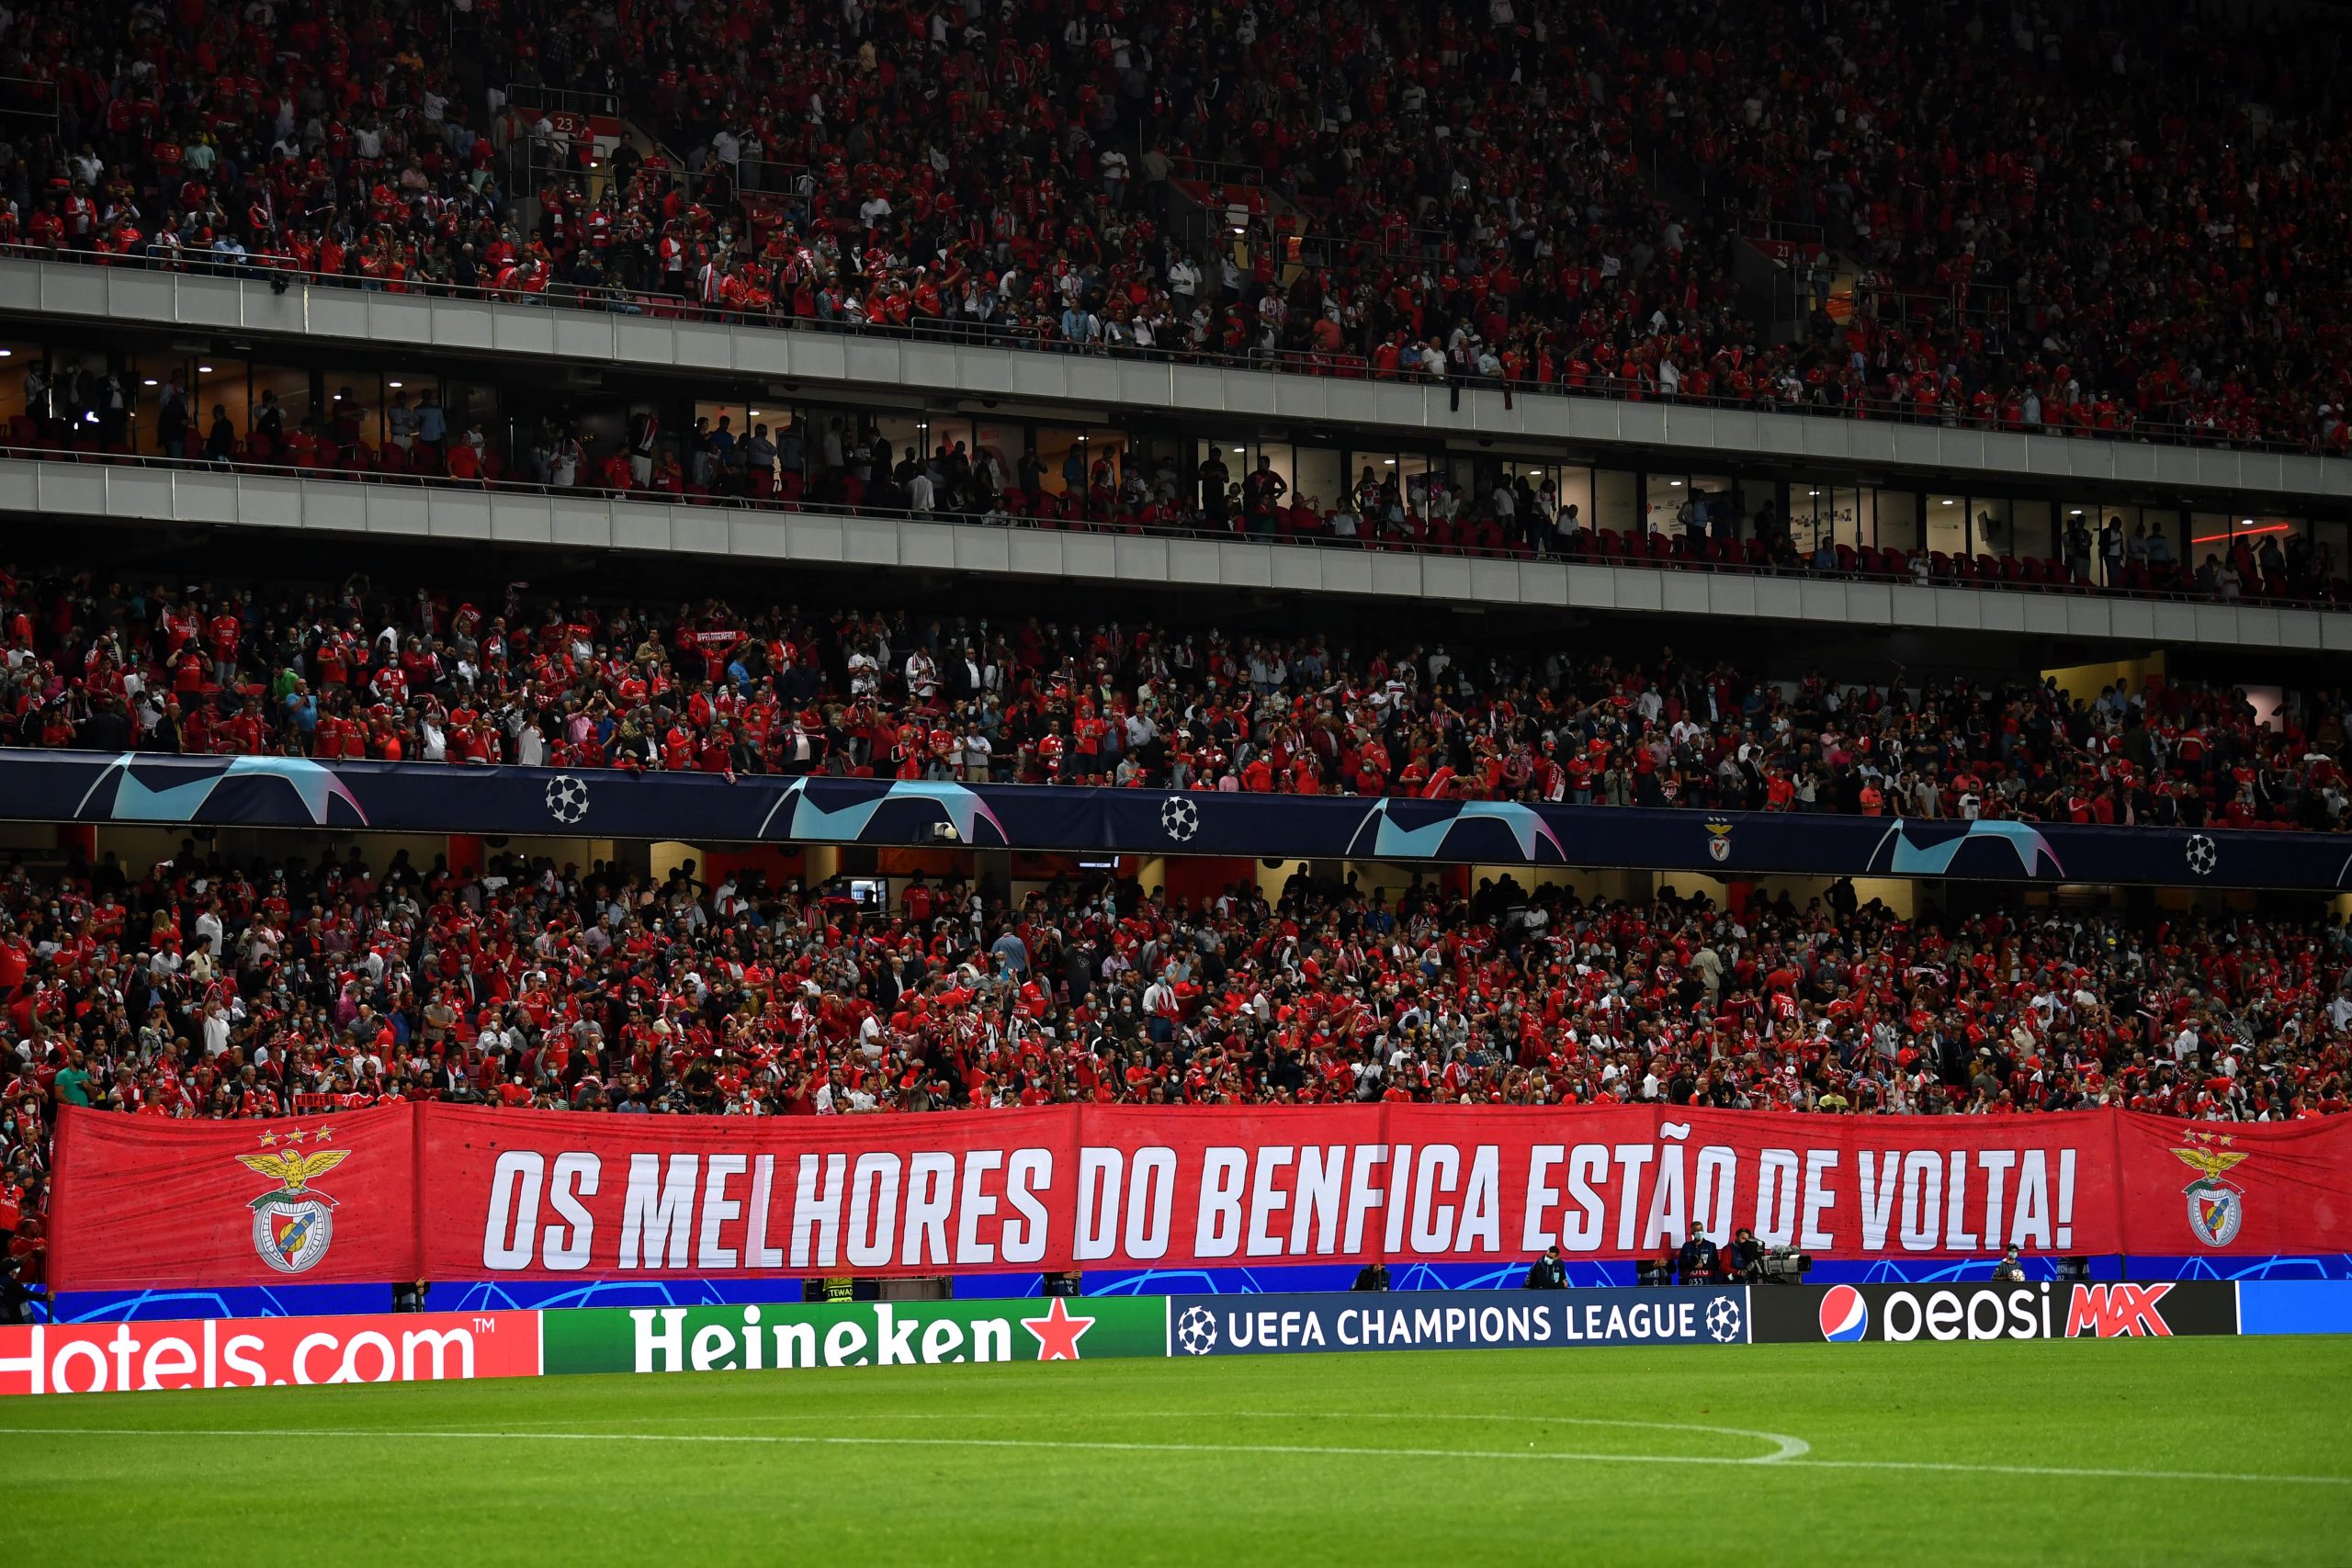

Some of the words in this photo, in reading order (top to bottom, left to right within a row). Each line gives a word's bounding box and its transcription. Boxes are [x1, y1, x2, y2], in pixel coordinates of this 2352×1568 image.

[558, 117, 573, 130] 23
[1777, 245, 1789, 257] 21
[1781, 1002, 1795, 1017] 28
[482, 1150, 602, 1270] OS
[617, 1148, 1053, 1269] MELHORES
[1072, 1146, 1178, 1260] DO
[1193, 1144, 1500, 1258] BENFICA
[1521, 1122, 1737, 1252] ESTÃO
[1749, 1148, 1839, 1251] DE
[1858, 1148, 2078, 1251] VOLTA!
[1228, 1311, 1326, 1348] UEFA
[1337, 1305, 1552, 1347] CHAMPIONS
[1566, 1303, 1696, 1341] LEAGUE
[1883, 1281, 2052, 1342] pepsi
[2064, 1282, 2177, 1339] MAX
[0, 1319, 475, 1395] Hotels.com
[629, 1303, 1012, 1374] Heineken
